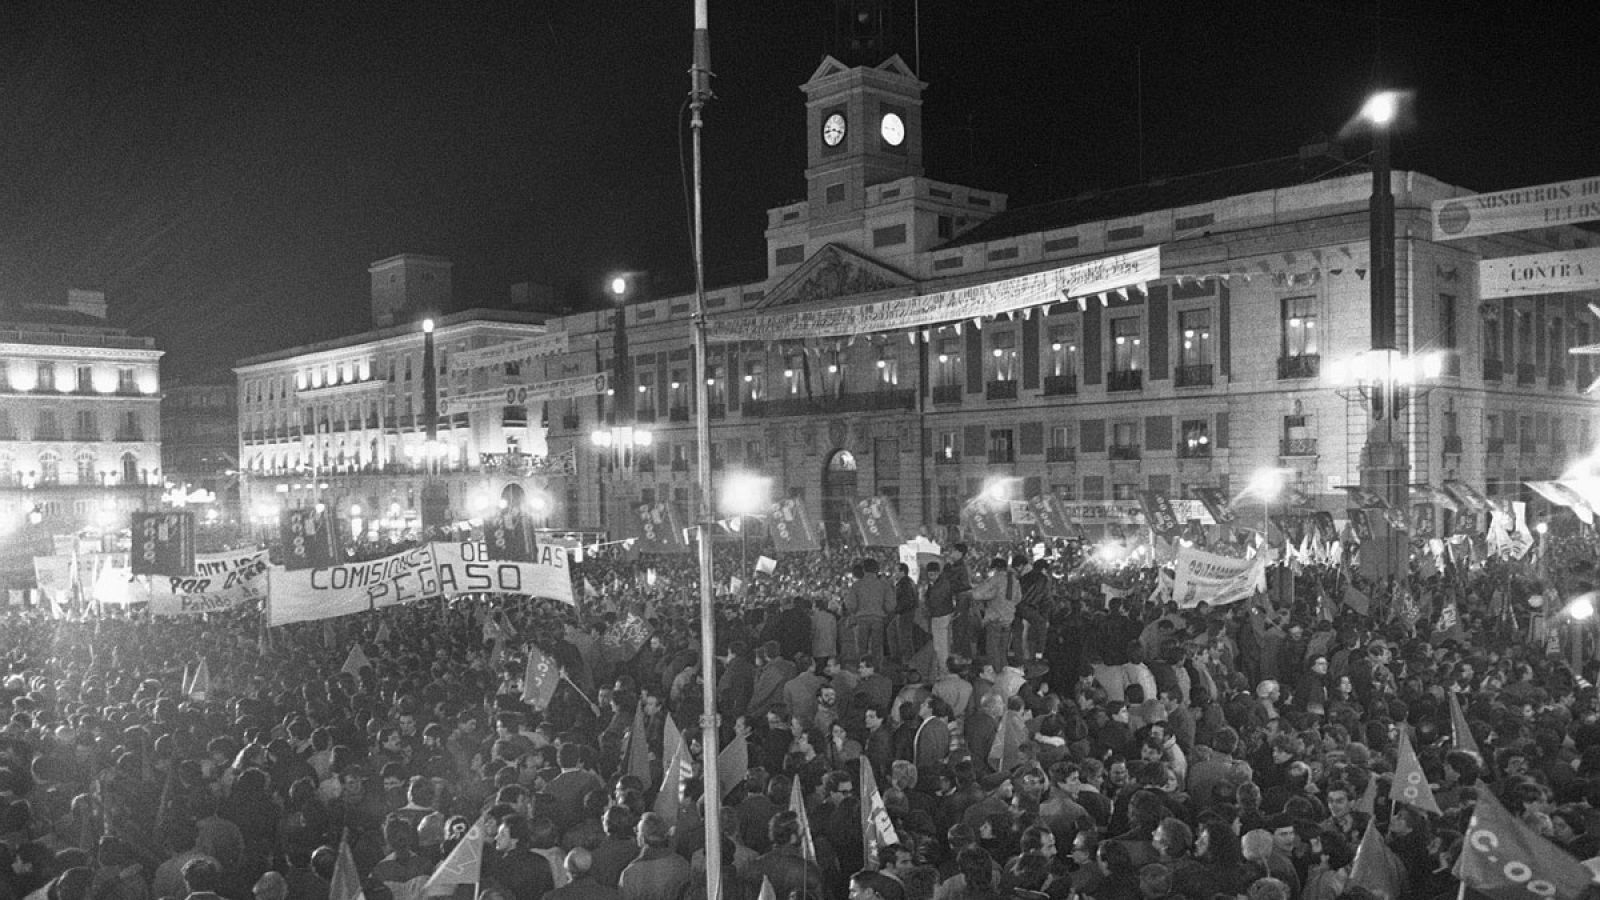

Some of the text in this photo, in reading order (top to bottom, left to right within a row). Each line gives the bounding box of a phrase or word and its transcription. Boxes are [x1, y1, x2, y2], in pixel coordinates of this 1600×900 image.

[1477, 184, 1571, 209] NOSOTROS
[1511, 263, 1584, 282] CONTRA
[170, 577, 211, 594] POR
[367, 563, 521, 610] PEGASO
